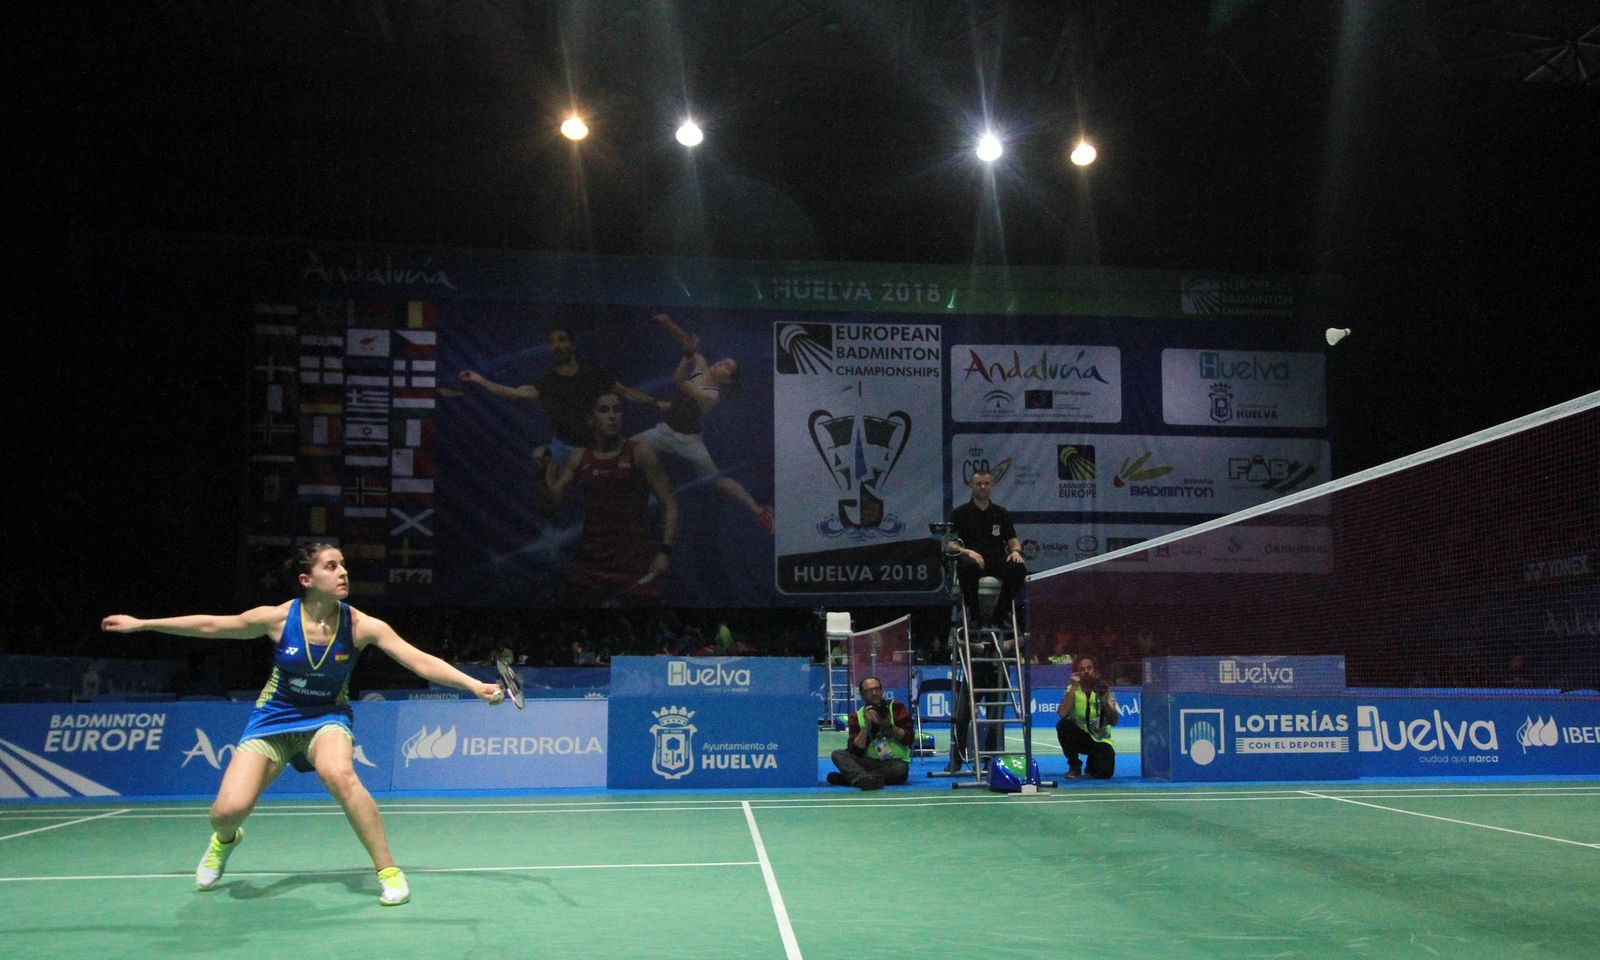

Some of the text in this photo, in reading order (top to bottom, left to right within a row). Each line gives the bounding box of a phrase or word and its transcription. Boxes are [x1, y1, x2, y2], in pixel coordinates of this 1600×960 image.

[772, 278, 941, 302] HUELVA 2018
[836, 325, 939, 341] EUROPEAN
[836, 347, 939, 361] BADMINTON
[836, 366, 940, 377] CHAMPIONSHIPS
[1200, 352, 1290, 380] Huelva
[1236, 410, 1279, 420] HUELVA
[1059, 489, 1097, 499] EUROPE
[794, 564, 929, 582] HUELVA 2018
[668, 661, 750, 686] Huelva
[1219, 660, 1294, 684] Huelva
[50, 713, 166, 729] BADMINTON
[1234, 710, 1349, 733] LOTERÍAS
[1357, 705, 1499, 752] Huelva
[44, 729, 163, 752] EUROPE
[462, 736, 604, 756] IBERDROLA
[703, 742, 778, 752] Ayuntamiento de
[1248, 742, 1271, 750] CON
[1289, 741, 1337, 749] DEPORTE
[702, 754, 778, 769] HUELVA
[1419, 755, 1499, 764] ciudad que marca
